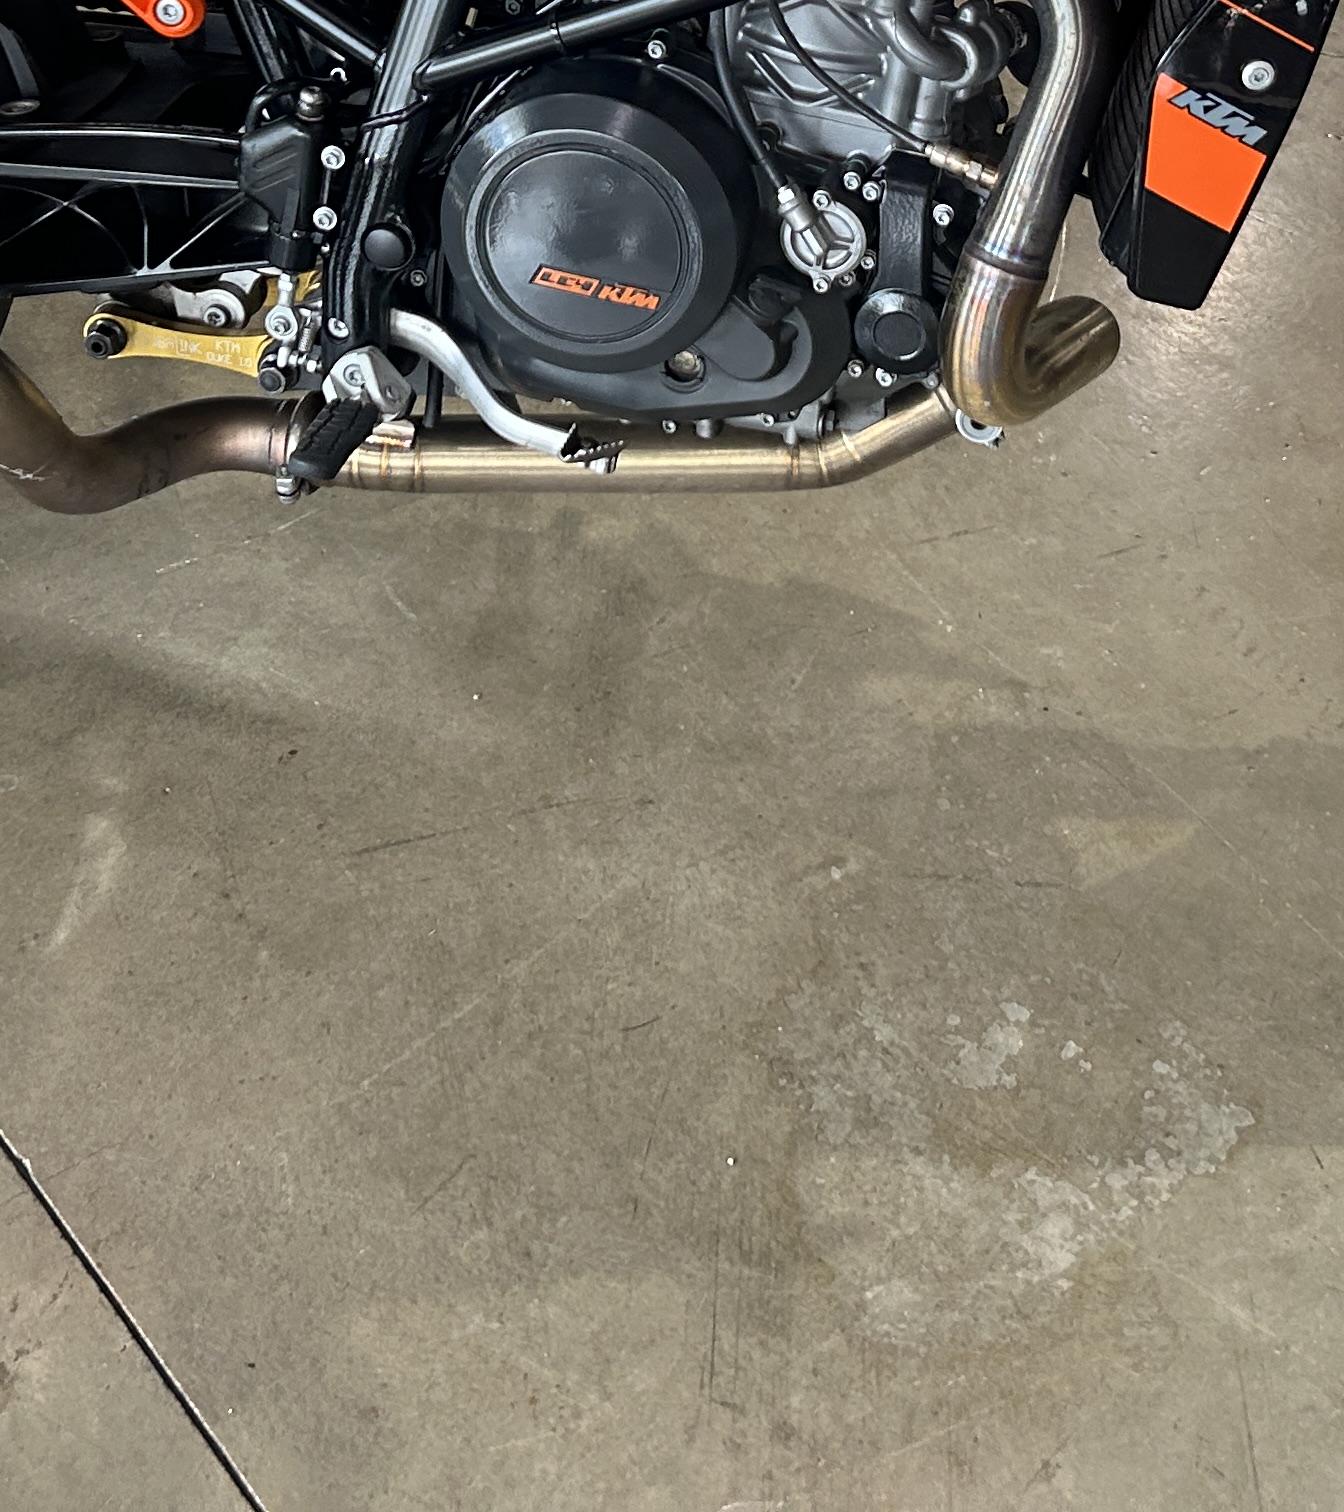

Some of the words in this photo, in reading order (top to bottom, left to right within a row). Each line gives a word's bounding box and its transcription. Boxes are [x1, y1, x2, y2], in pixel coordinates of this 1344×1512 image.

[1170, 89, 1268, 146] KTM
[597, 283, 660, 311] KTM
[215, 339, 240, 353] KTM
